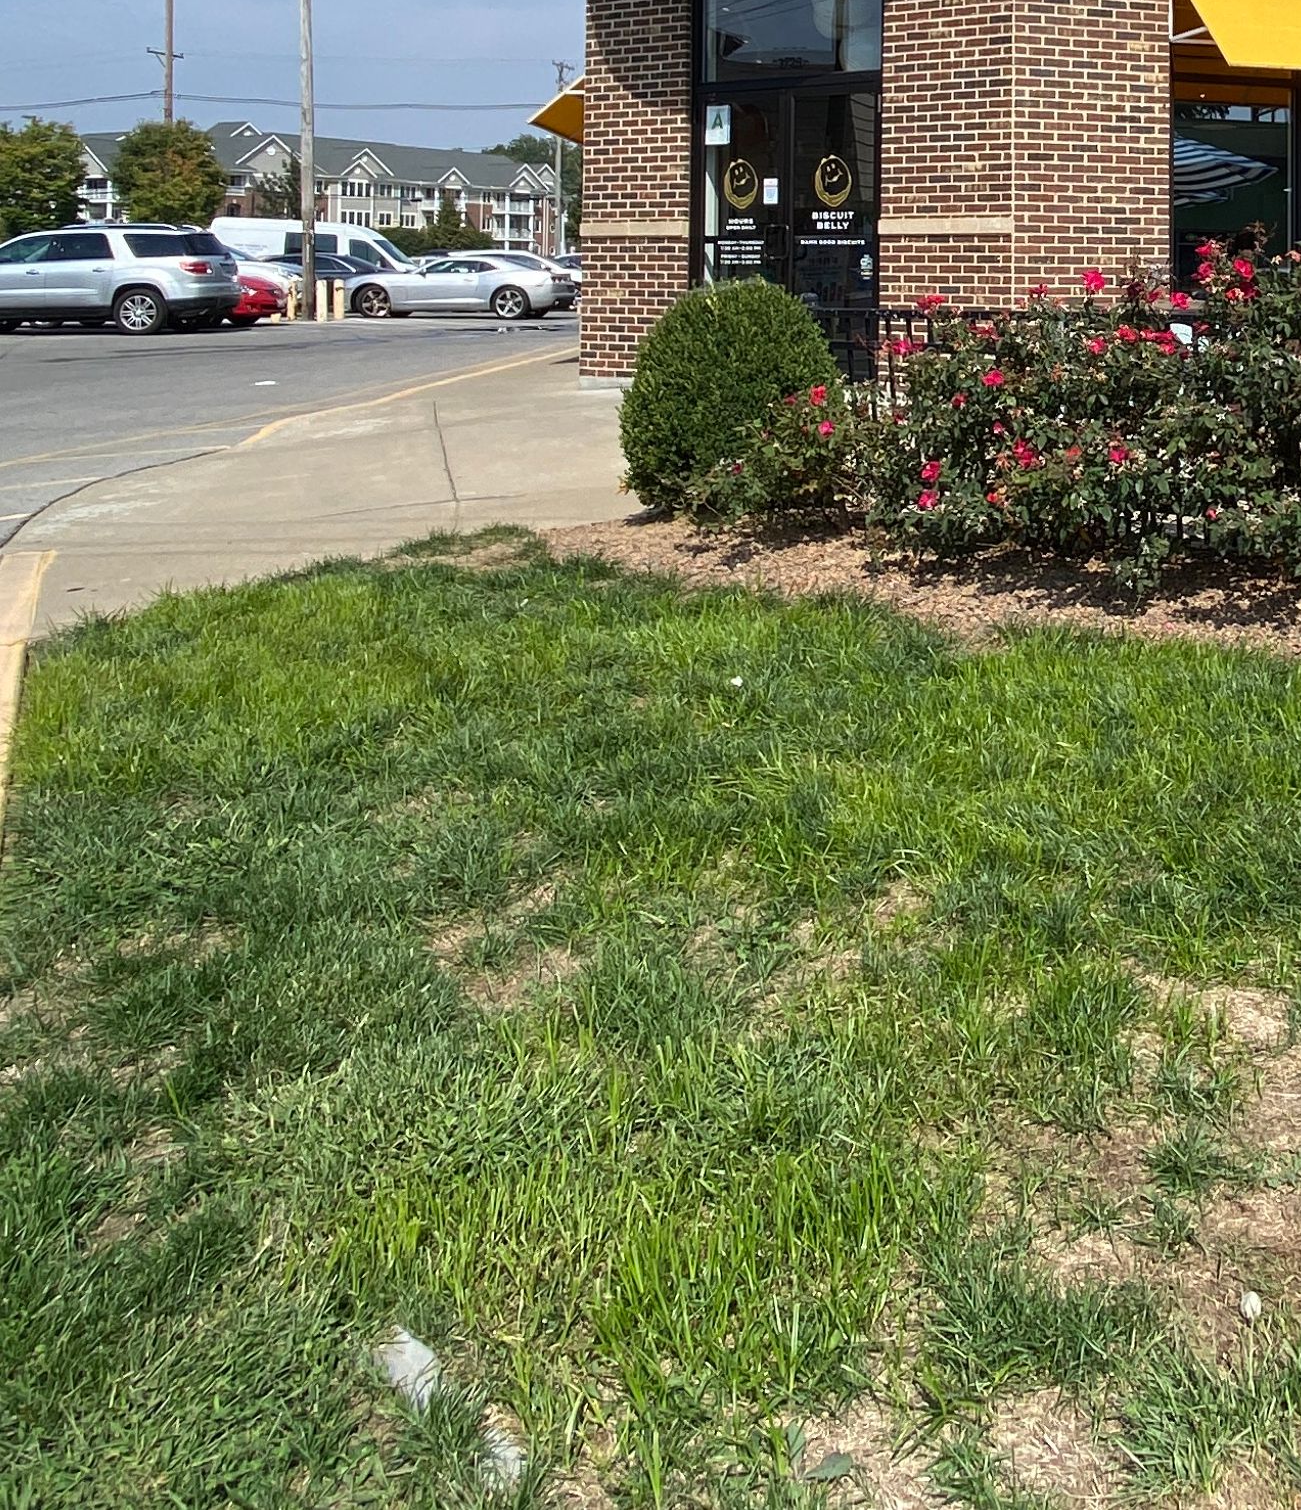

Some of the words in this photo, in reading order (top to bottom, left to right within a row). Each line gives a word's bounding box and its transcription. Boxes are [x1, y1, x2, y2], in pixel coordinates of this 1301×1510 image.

[711, 111, 724, 130] A
[811, 211, 855, 220] BISCUIT
[816, 221, 850, 230] BELLY
